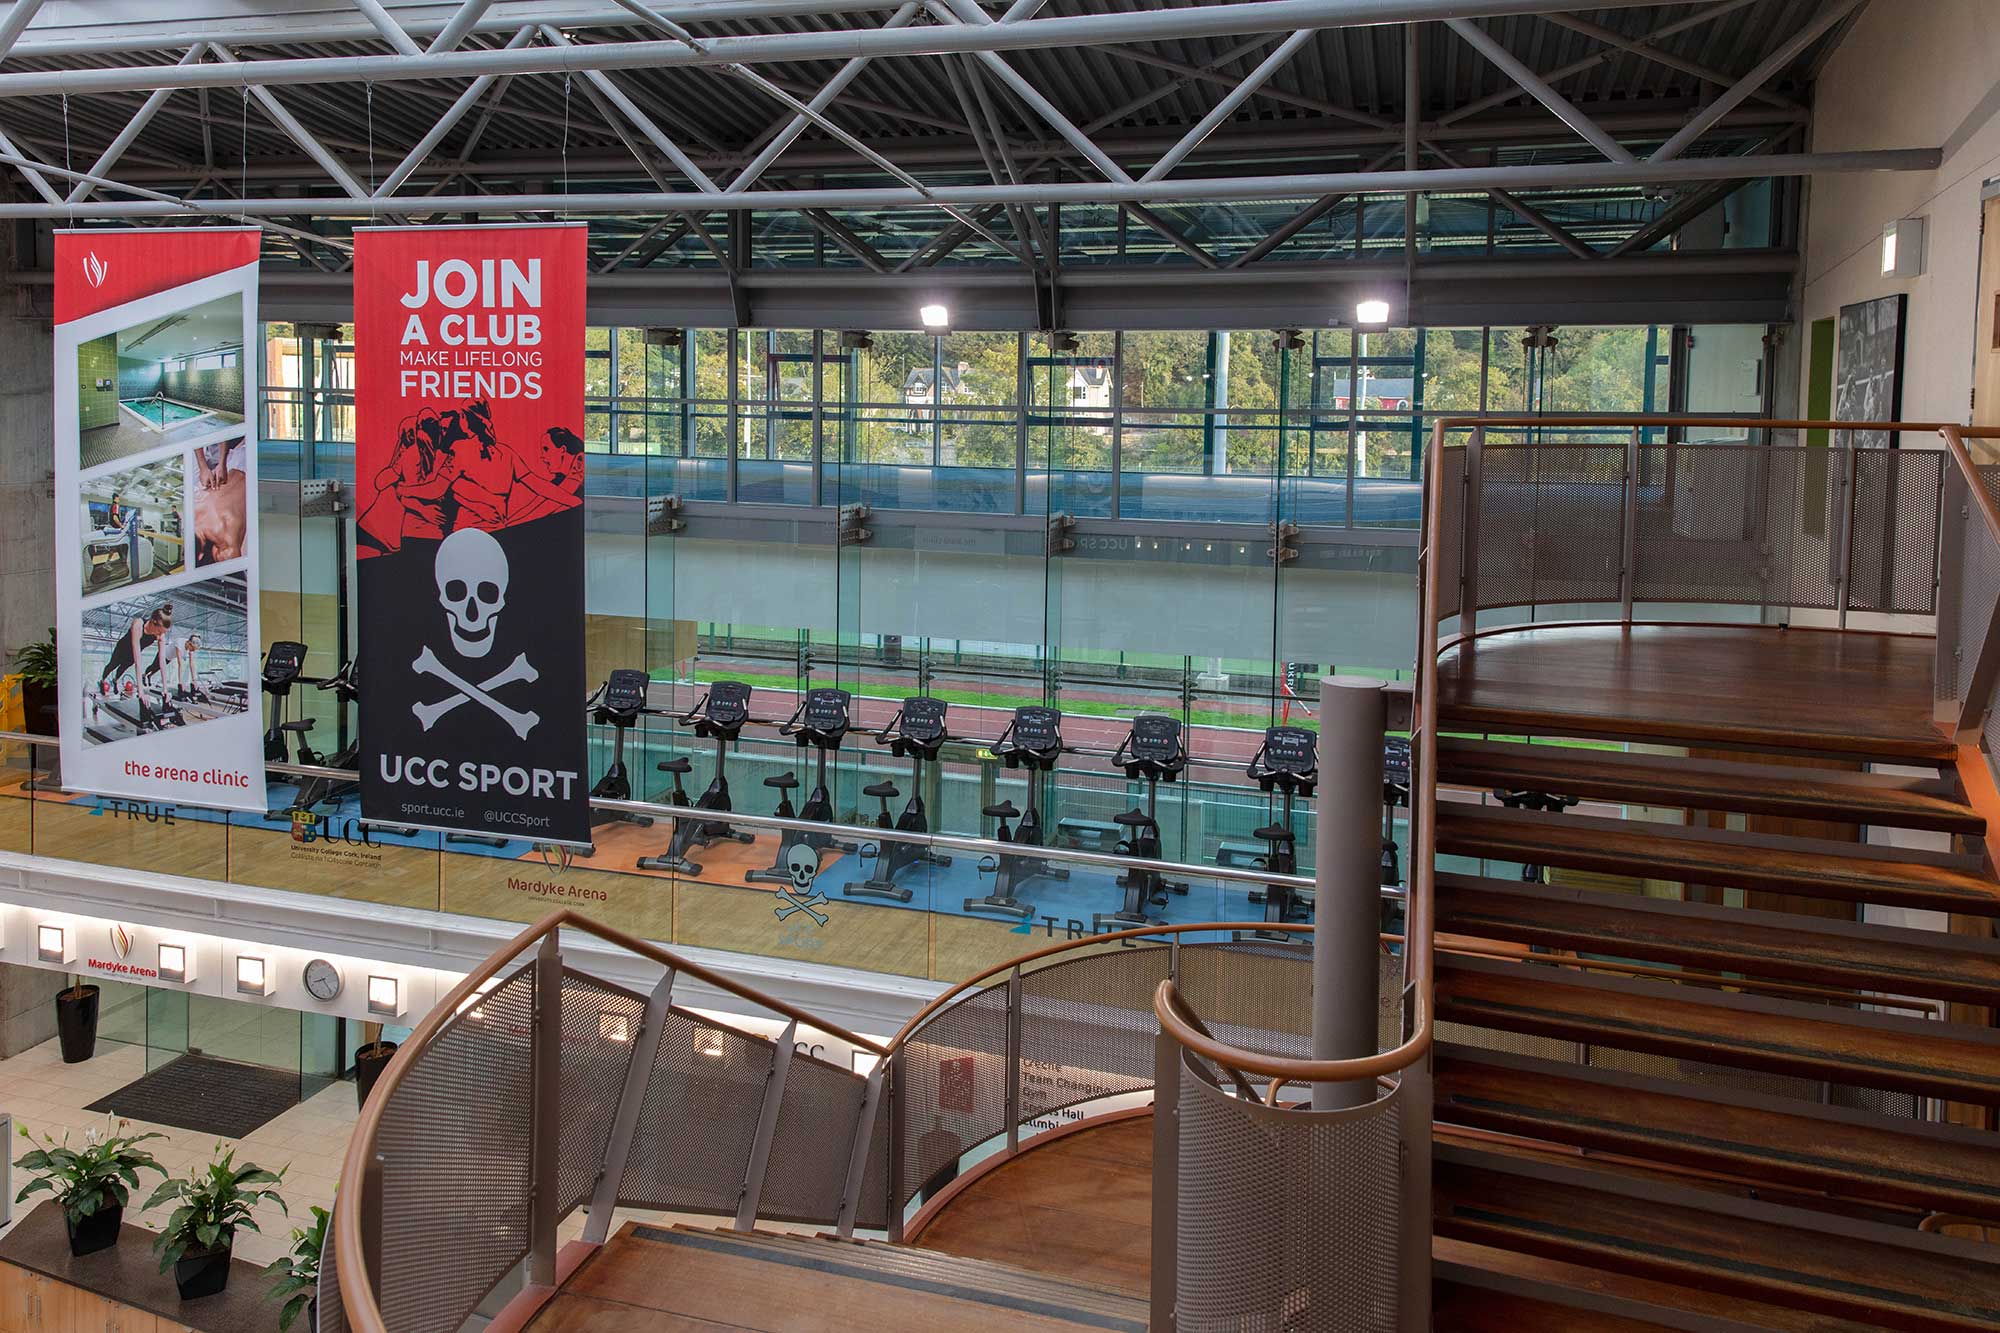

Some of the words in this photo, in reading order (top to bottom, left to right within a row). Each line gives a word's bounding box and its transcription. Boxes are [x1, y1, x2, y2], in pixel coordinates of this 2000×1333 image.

[399, 258, 542, 309] JOIN
[400, 314, 430, 346] A
[439, 314, 542, 346] CLUB
[400, 350, 449, 366] MAKE
[455, 351, 543, 367] LIFELONG
[400, 370, 543, 400] FRIENDS
[124, 760, 151, 777] the
[154, 765, 199, 783] arena
[202, 768, 249, 788] clinic
[379, 753, 450, 788] UCC
[458, 761, 578, 801] SPORT
[110, 800, 177, 826] TRUE
[401, 803, 465, 818] sport.ucc.ie
[484, 810, 550, 828] @UCCSport
[323, 816, 382, 849] UCC
[507, 877, 565, 896] Mardyke
[568, 885, 608, 901] Arena
[88, 958, 129, 973] Mardyke
[129, 965, 157, 977] Arena
[1062, 1109, 1084, 1120] Hall
